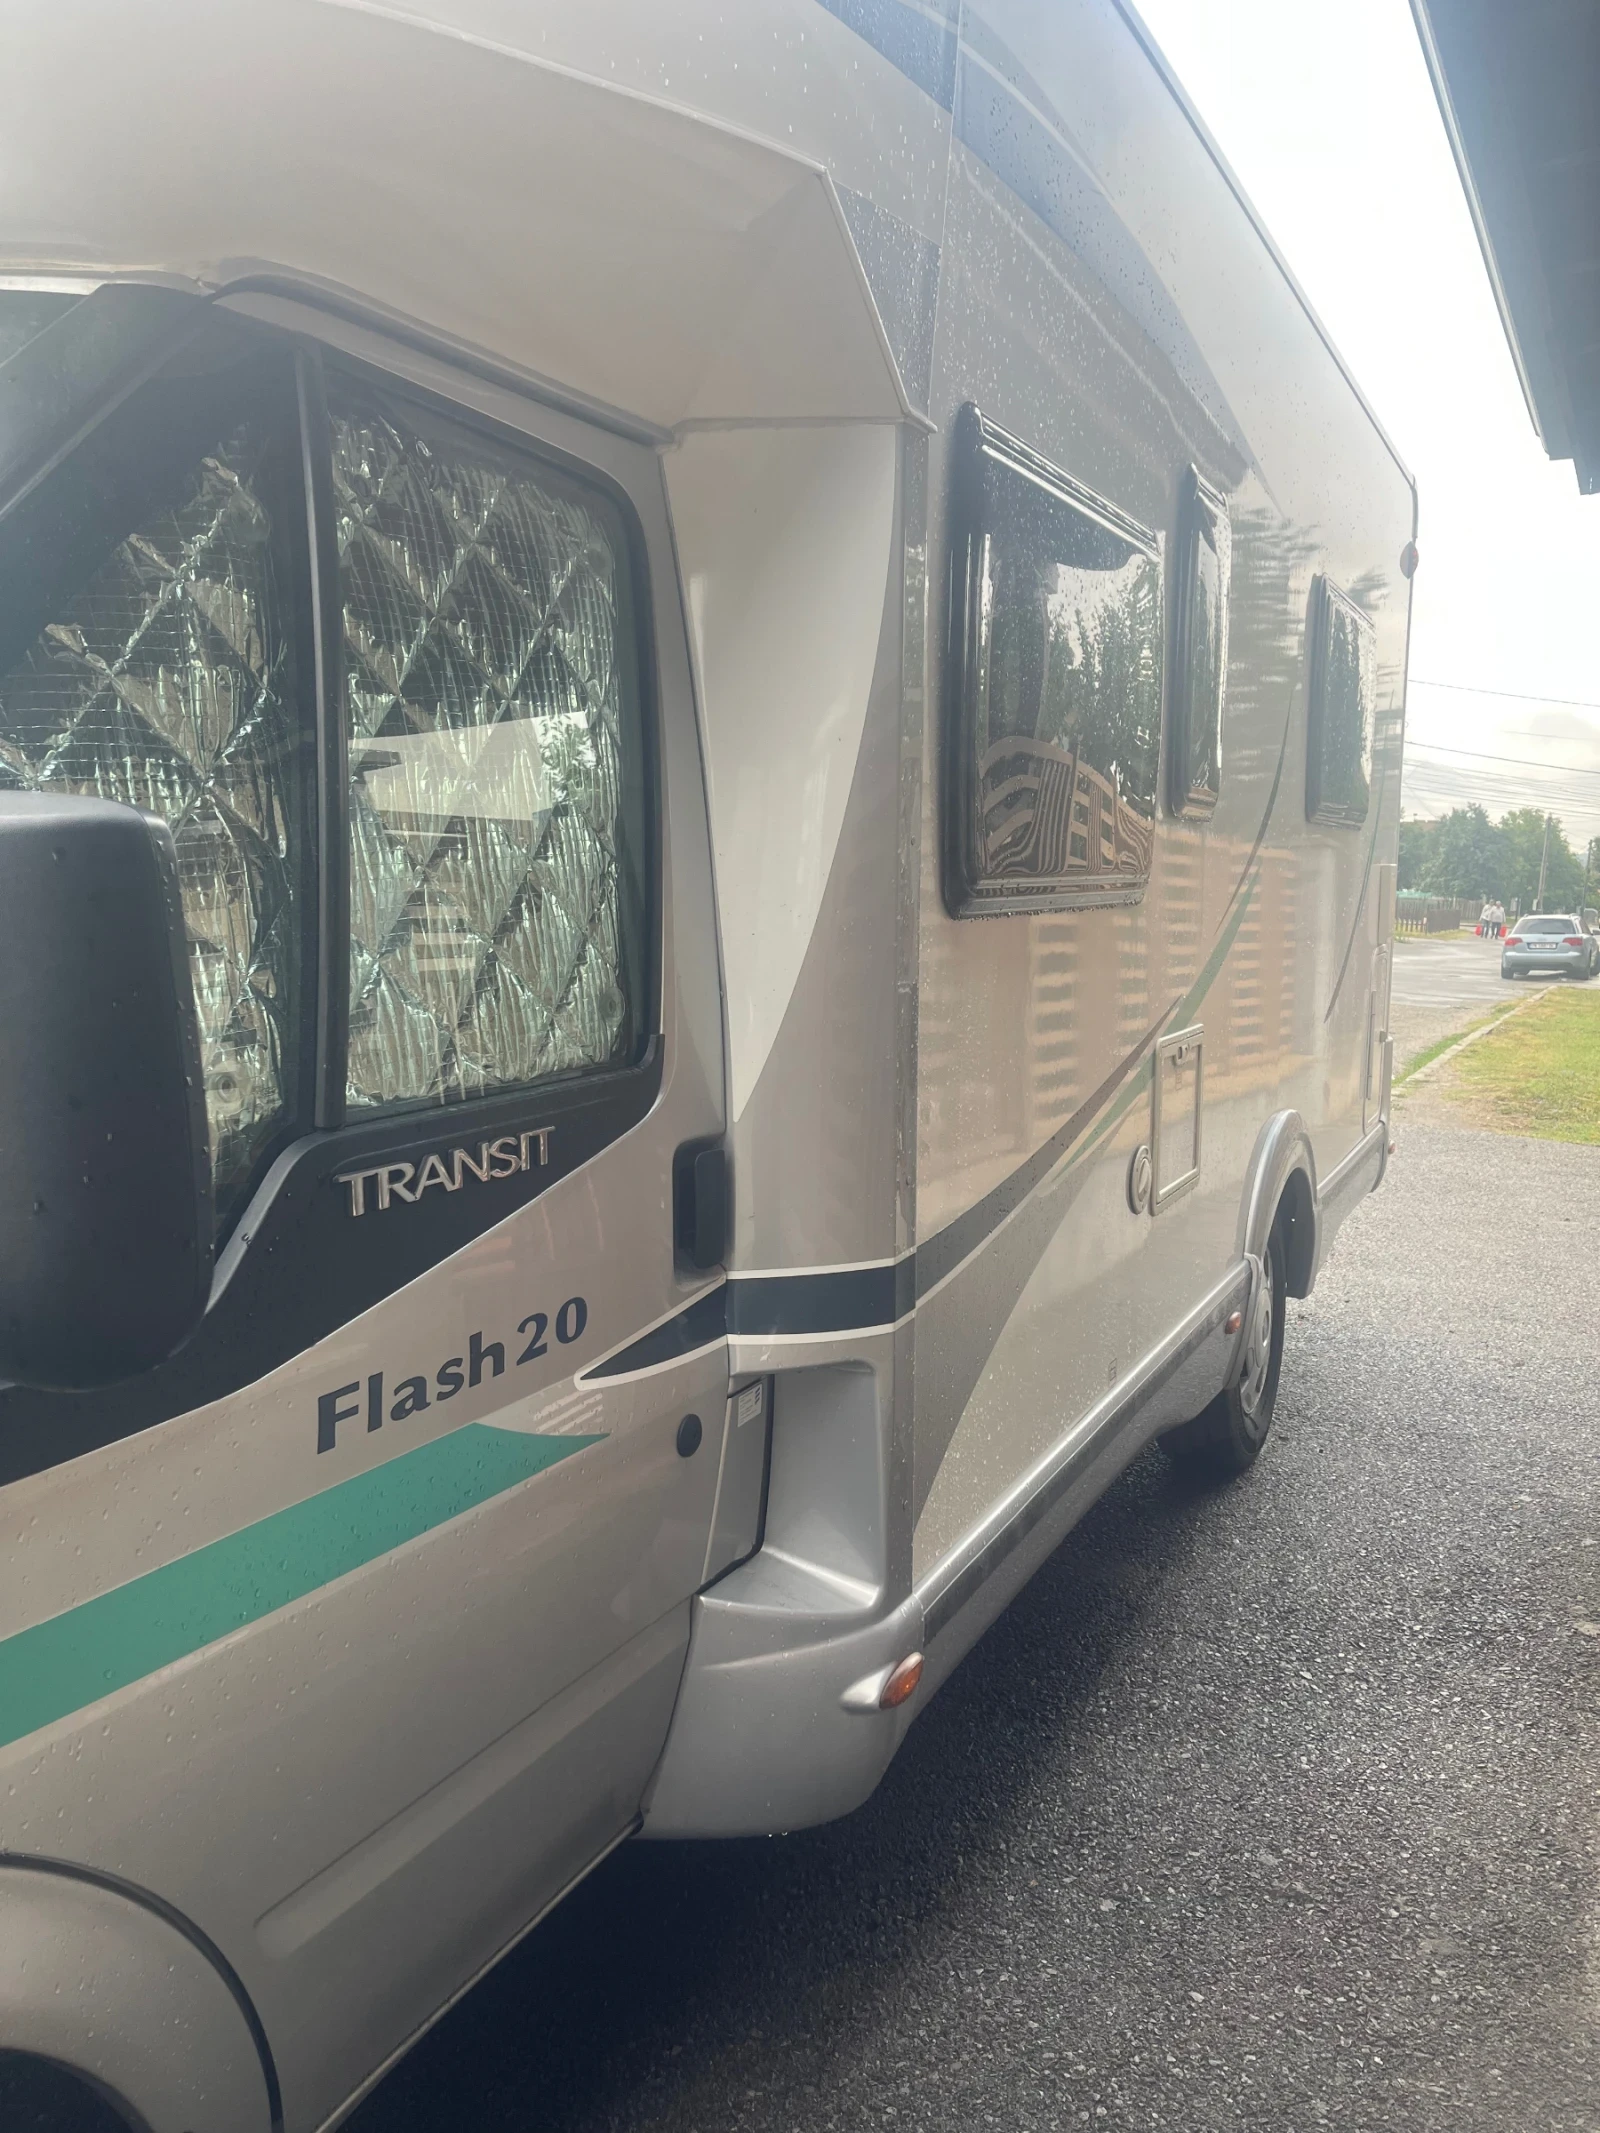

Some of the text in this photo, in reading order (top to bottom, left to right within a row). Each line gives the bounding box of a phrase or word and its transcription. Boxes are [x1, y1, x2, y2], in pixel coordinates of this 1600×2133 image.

[334, 1126, 555, 1217] TRANSIT
[316, 1296, 589, 1455] Flash 20
